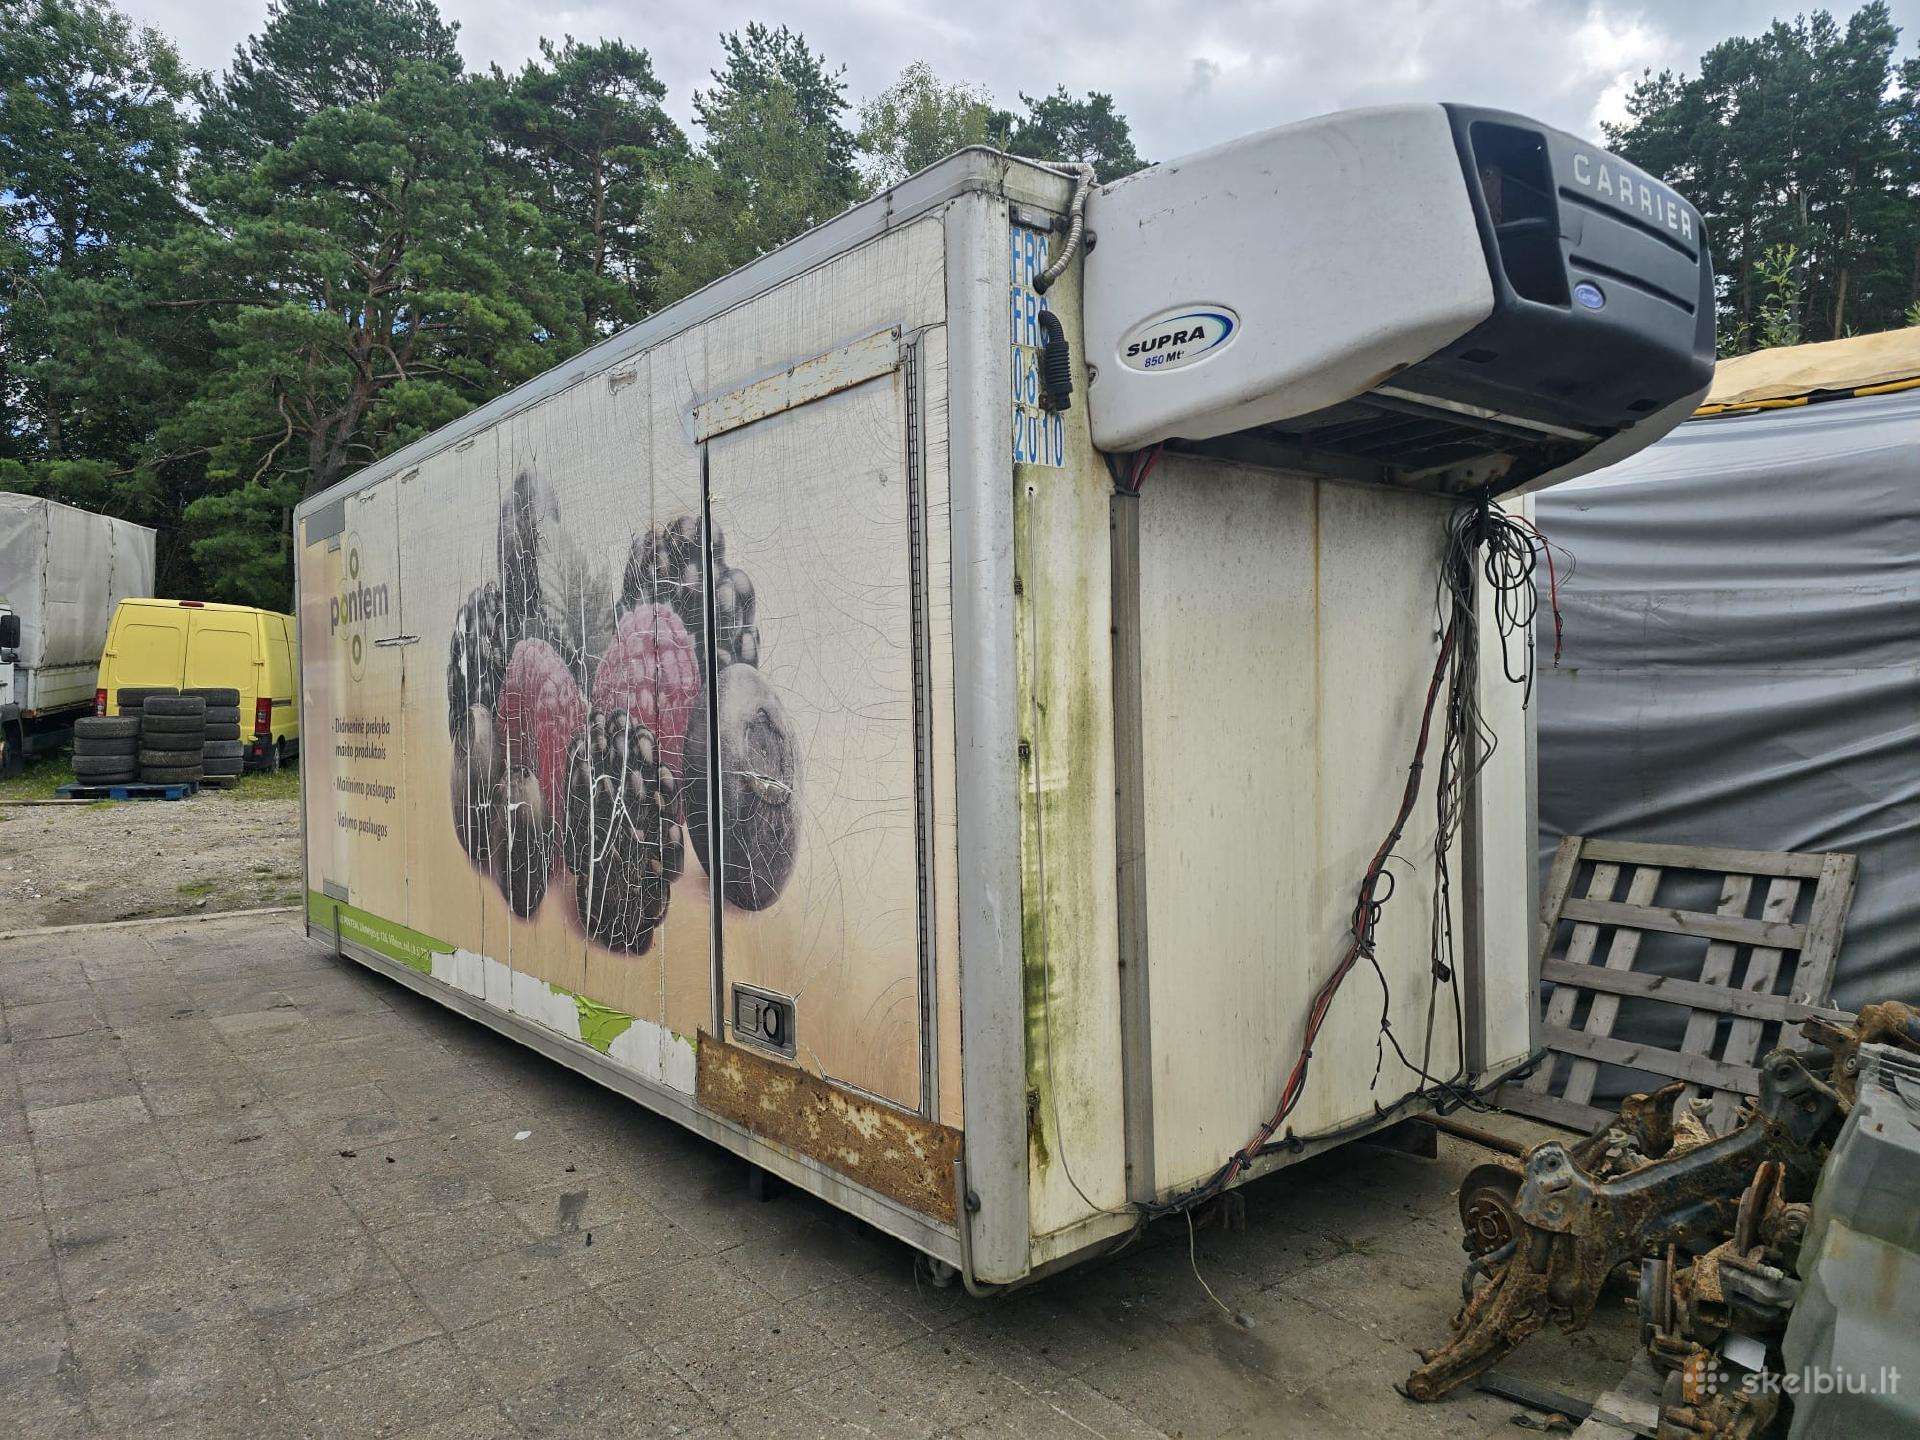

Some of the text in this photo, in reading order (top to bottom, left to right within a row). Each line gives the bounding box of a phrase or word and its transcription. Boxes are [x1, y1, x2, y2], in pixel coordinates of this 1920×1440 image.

[1573, 153, 1692, 240] CARRIER
[1126, 326, 1205, 357] SUPRA
[1144, 355, 1164, 368] 850
[1013, 408, 1064, 467] 2010
[330, 581, 388, 636] pontem
[365, 716, 390, 739] prekyba
